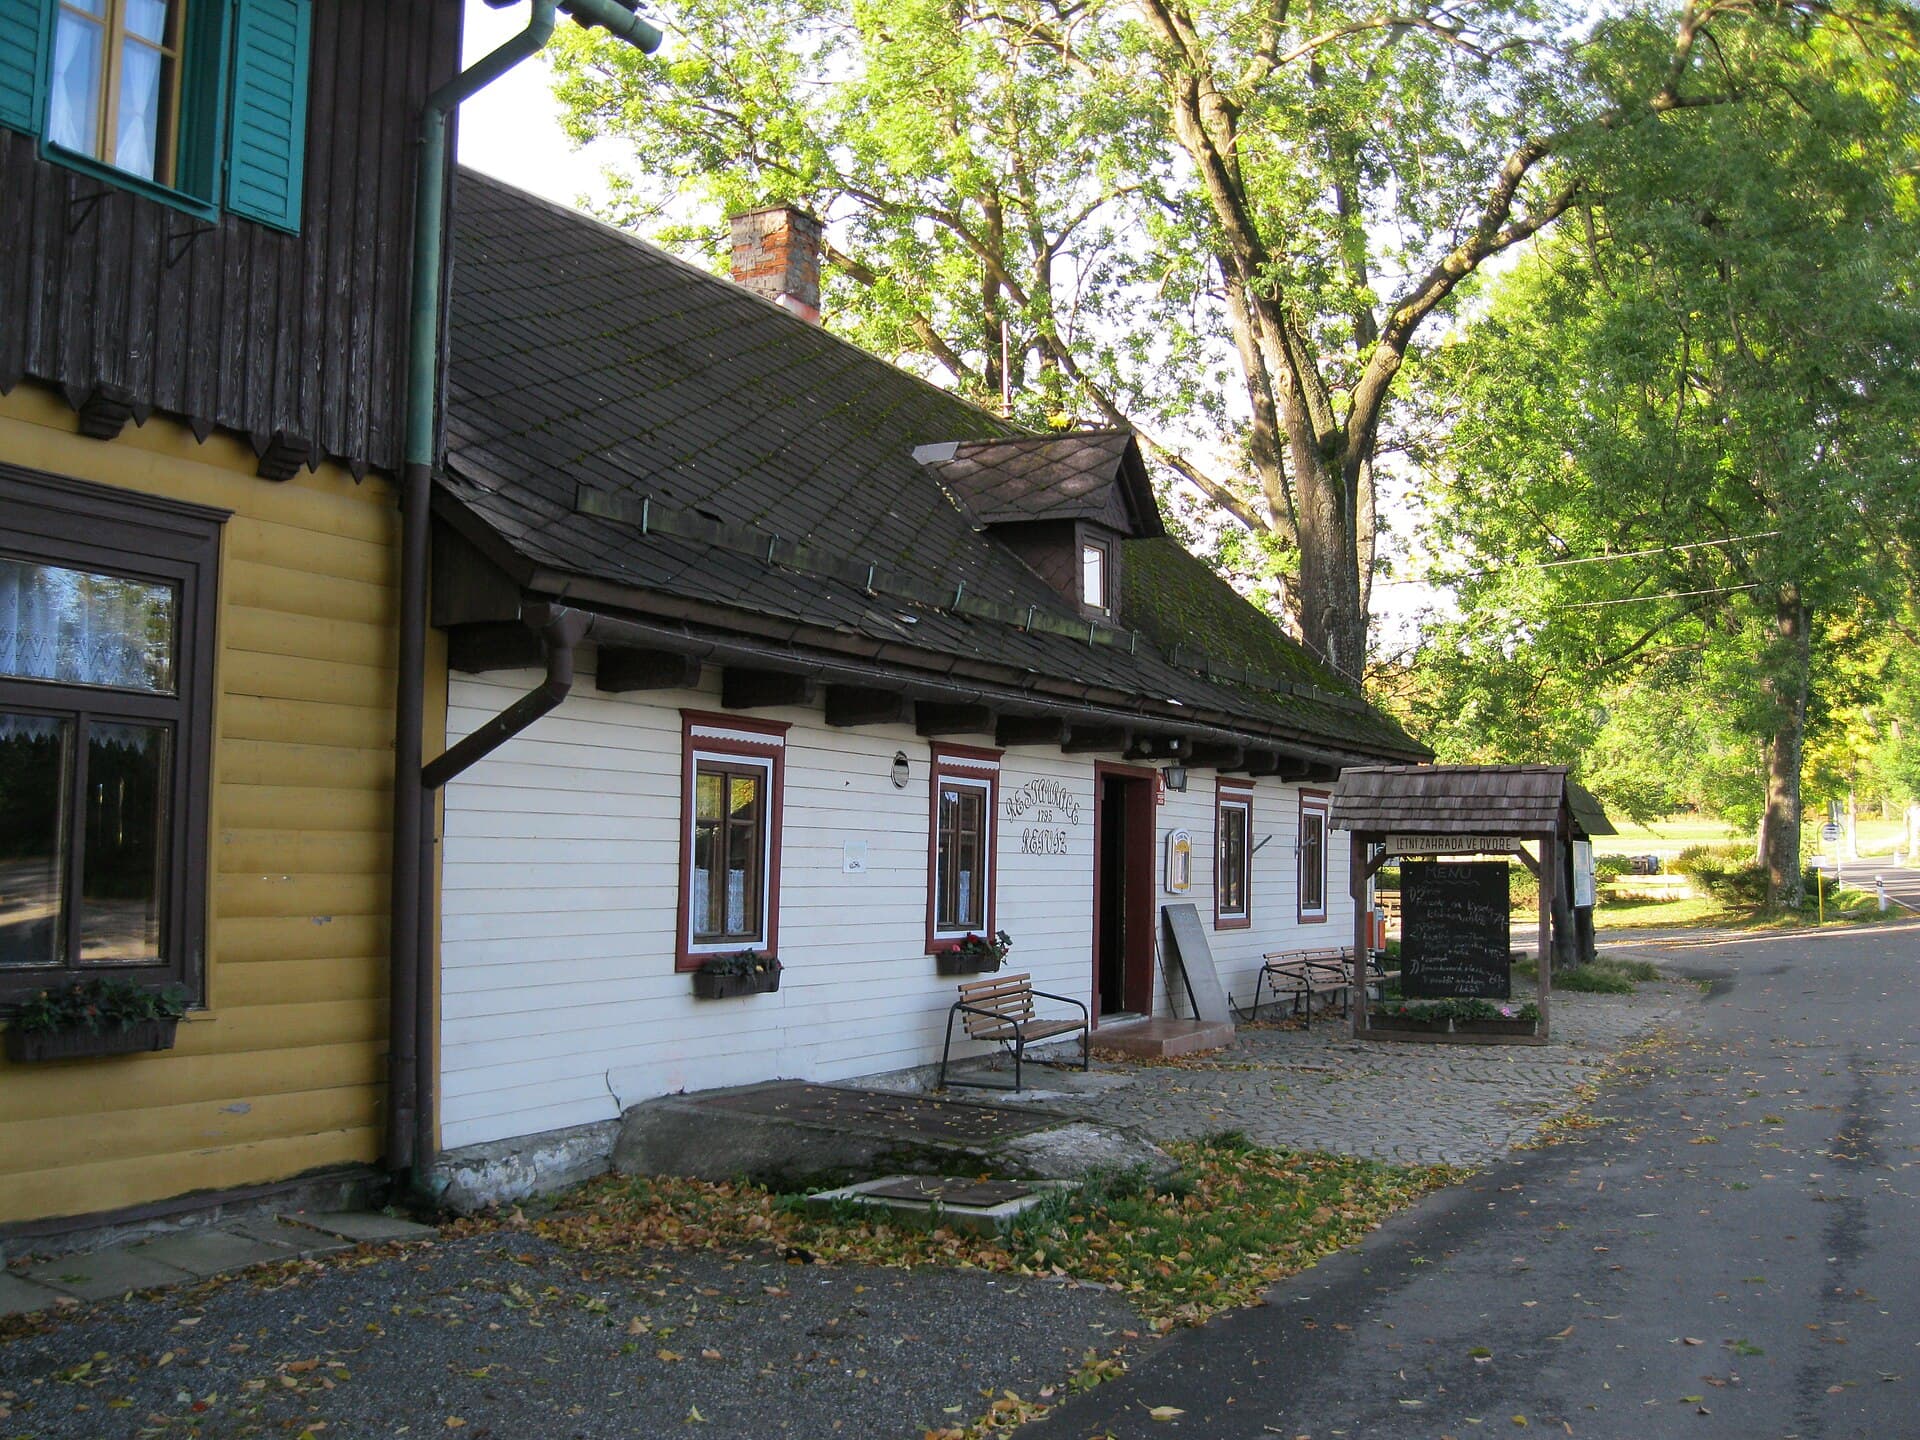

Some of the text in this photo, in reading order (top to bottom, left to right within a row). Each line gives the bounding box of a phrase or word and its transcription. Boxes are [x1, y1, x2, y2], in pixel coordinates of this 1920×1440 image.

[1006, 778, 1080, 825] RESTAURACE
[1037, 809, 1053, 823] 1795
[1419, 837, 1464, 850] ZAHRADA
[1466, 838, 1477, 850] VE
[1424, 864, 1473, 880] MENU
